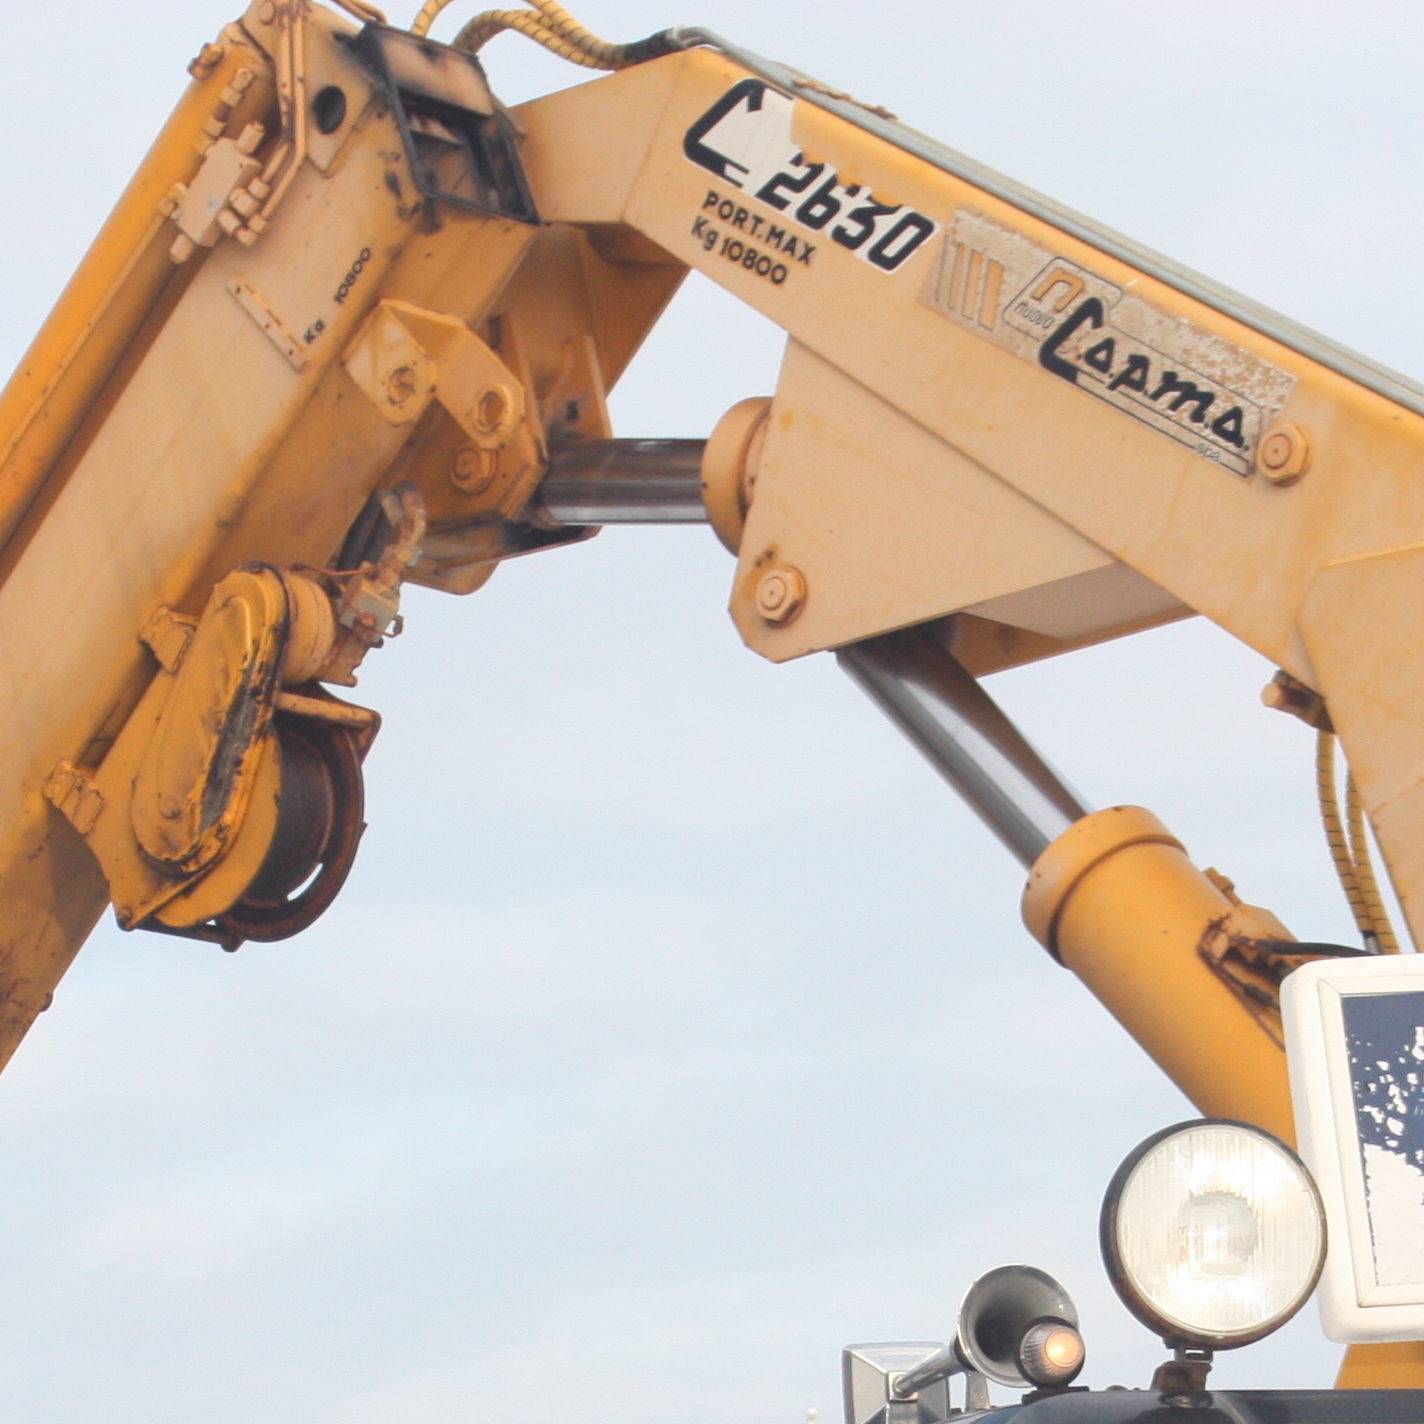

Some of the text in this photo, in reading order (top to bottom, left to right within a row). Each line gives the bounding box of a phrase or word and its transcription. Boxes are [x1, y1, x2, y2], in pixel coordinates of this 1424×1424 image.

[702, 190, 817, 267] PORT.MAX
[754, 151, 935, 272] 2630
[333, 247, 372, 305] 10800
[691, 216, 789, 286] Kg 10800
